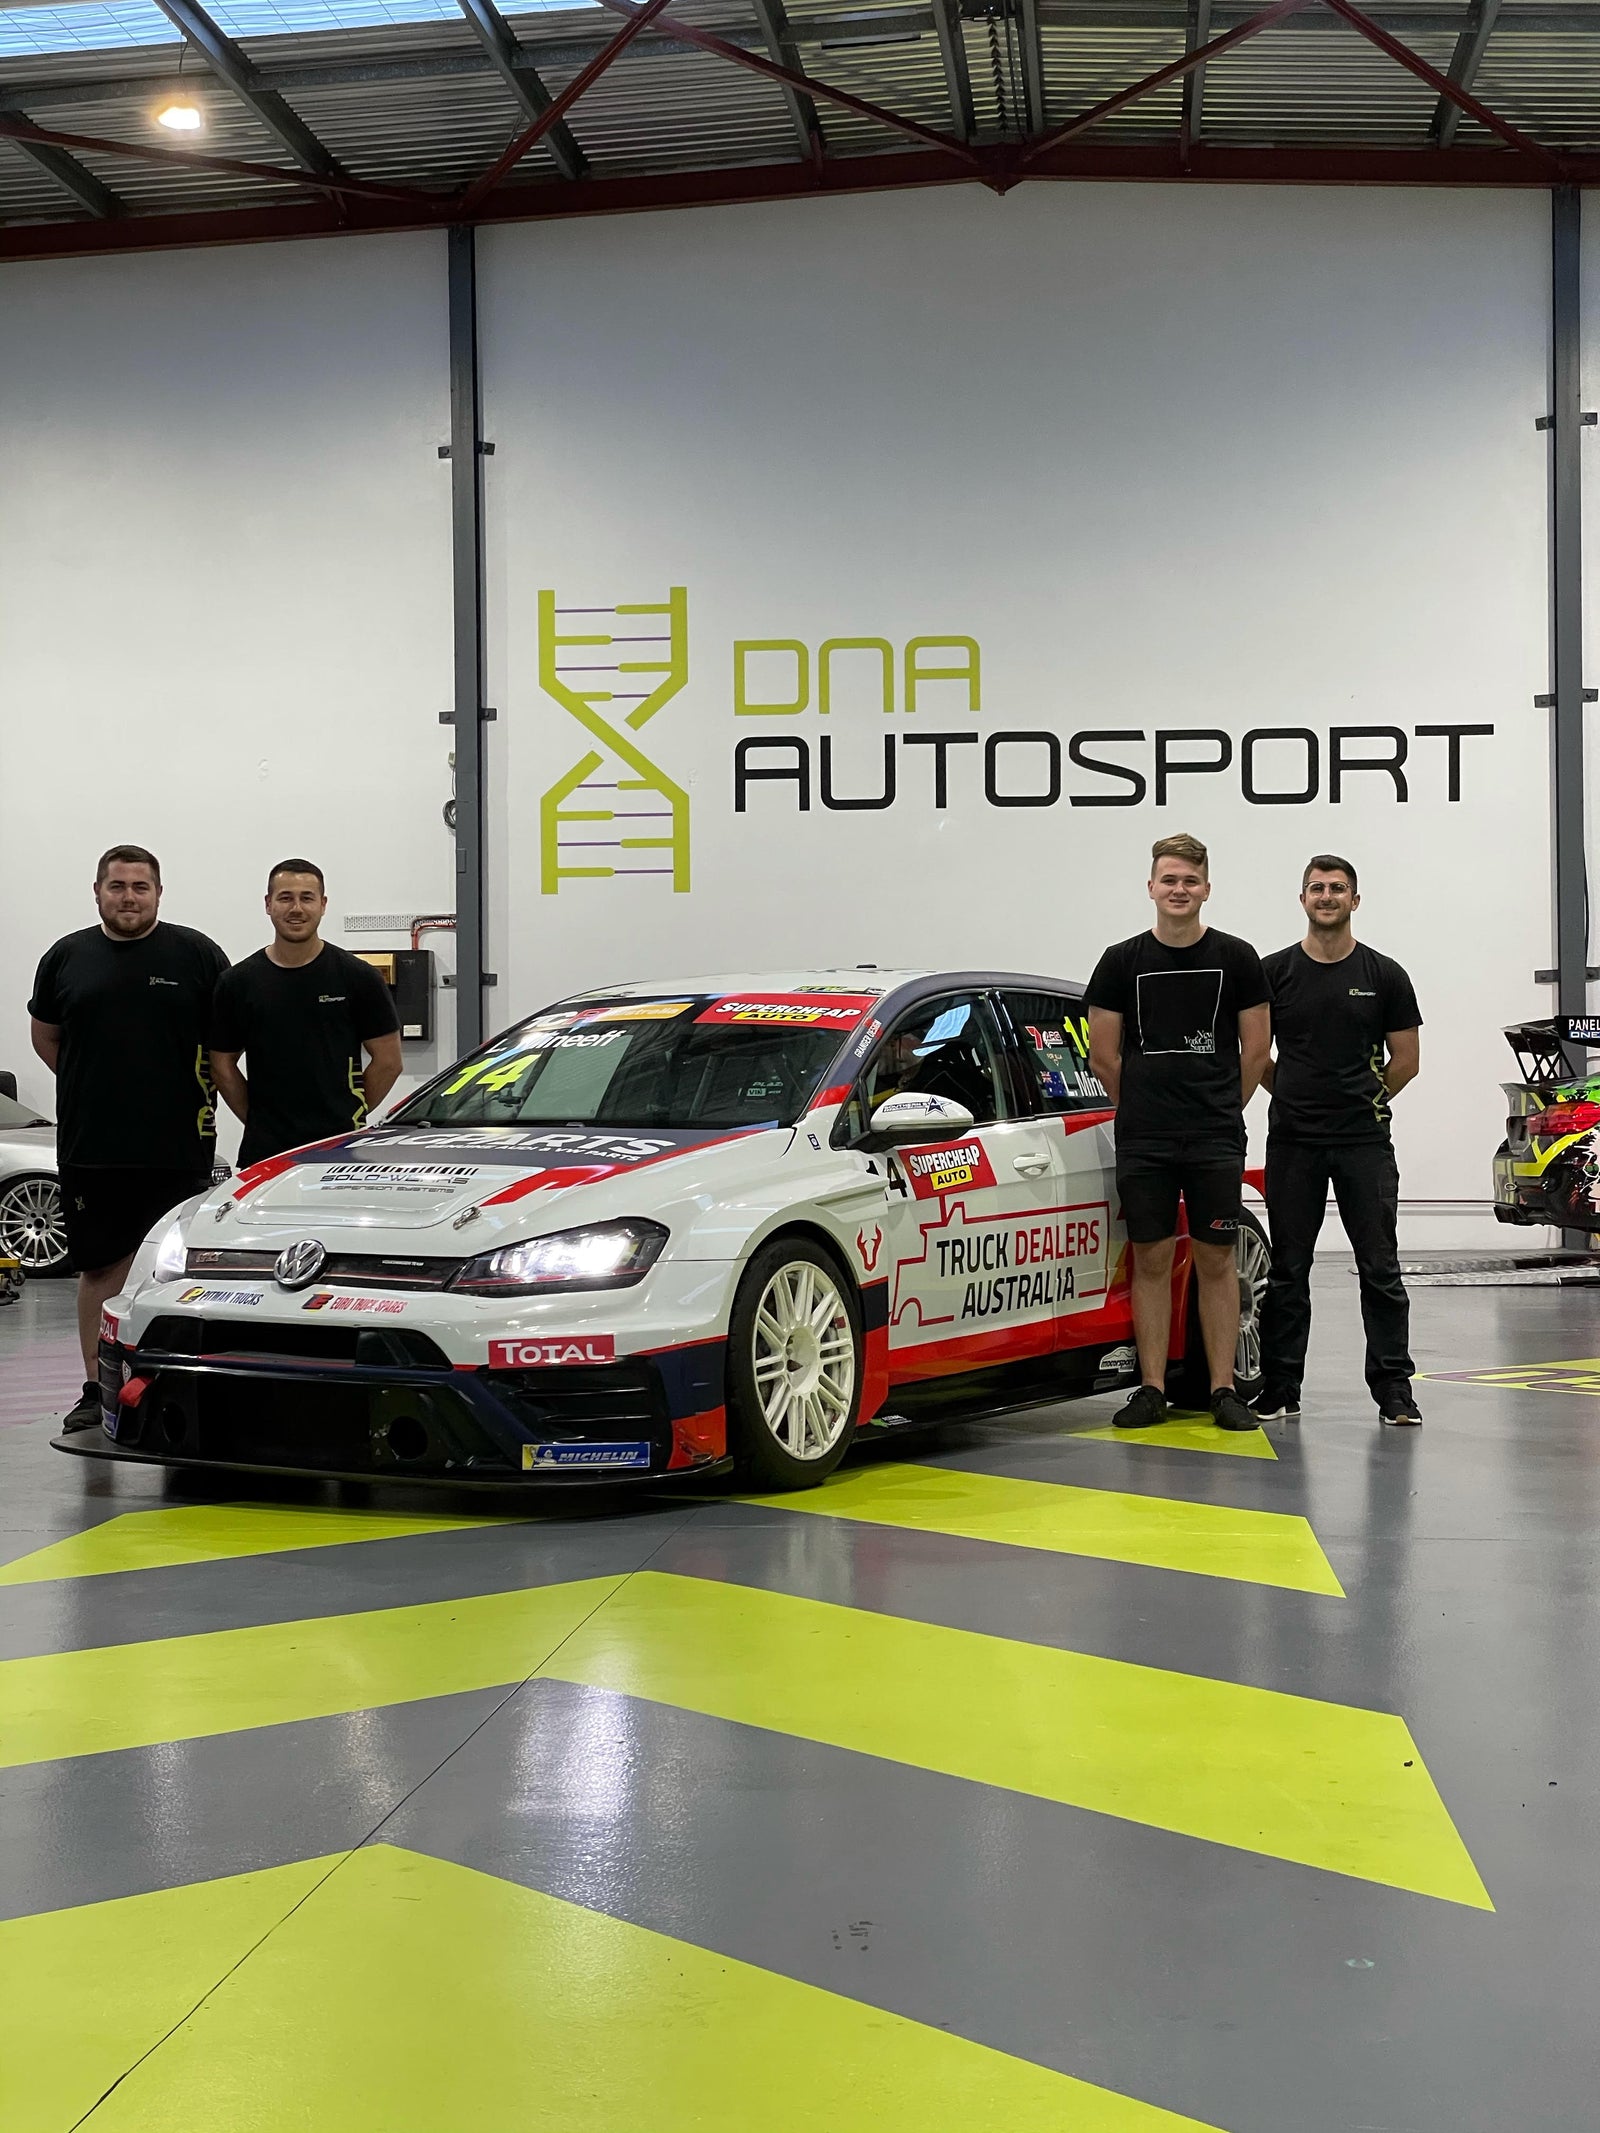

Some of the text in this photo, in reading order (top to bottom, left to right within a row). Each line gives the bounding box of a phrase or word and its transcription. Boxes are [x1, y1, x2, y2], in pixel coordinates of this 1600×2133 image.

[734, 635, 981, 716] DNA
[734, 724, 1495, 812] AUTOSPORT
[715, 1003, 862, 1018] SUPERCHEAP
[440, 1053, 543, 1097] 14
[909, 1145, 980, 1177] SUPERCHEAP
[937, 1169, 967, 1185] AUTO
[320, 1174, 470, 1185] SOLO-WEKS
[936, 1219, 1100, 1277] TRUCK DEALERS
[961, 1266, 1075, 1320] AUSTRALIA
[497, 1342, 606, 1364] TOTAL
[558, 1451, 639, 1462] MICHELIN
